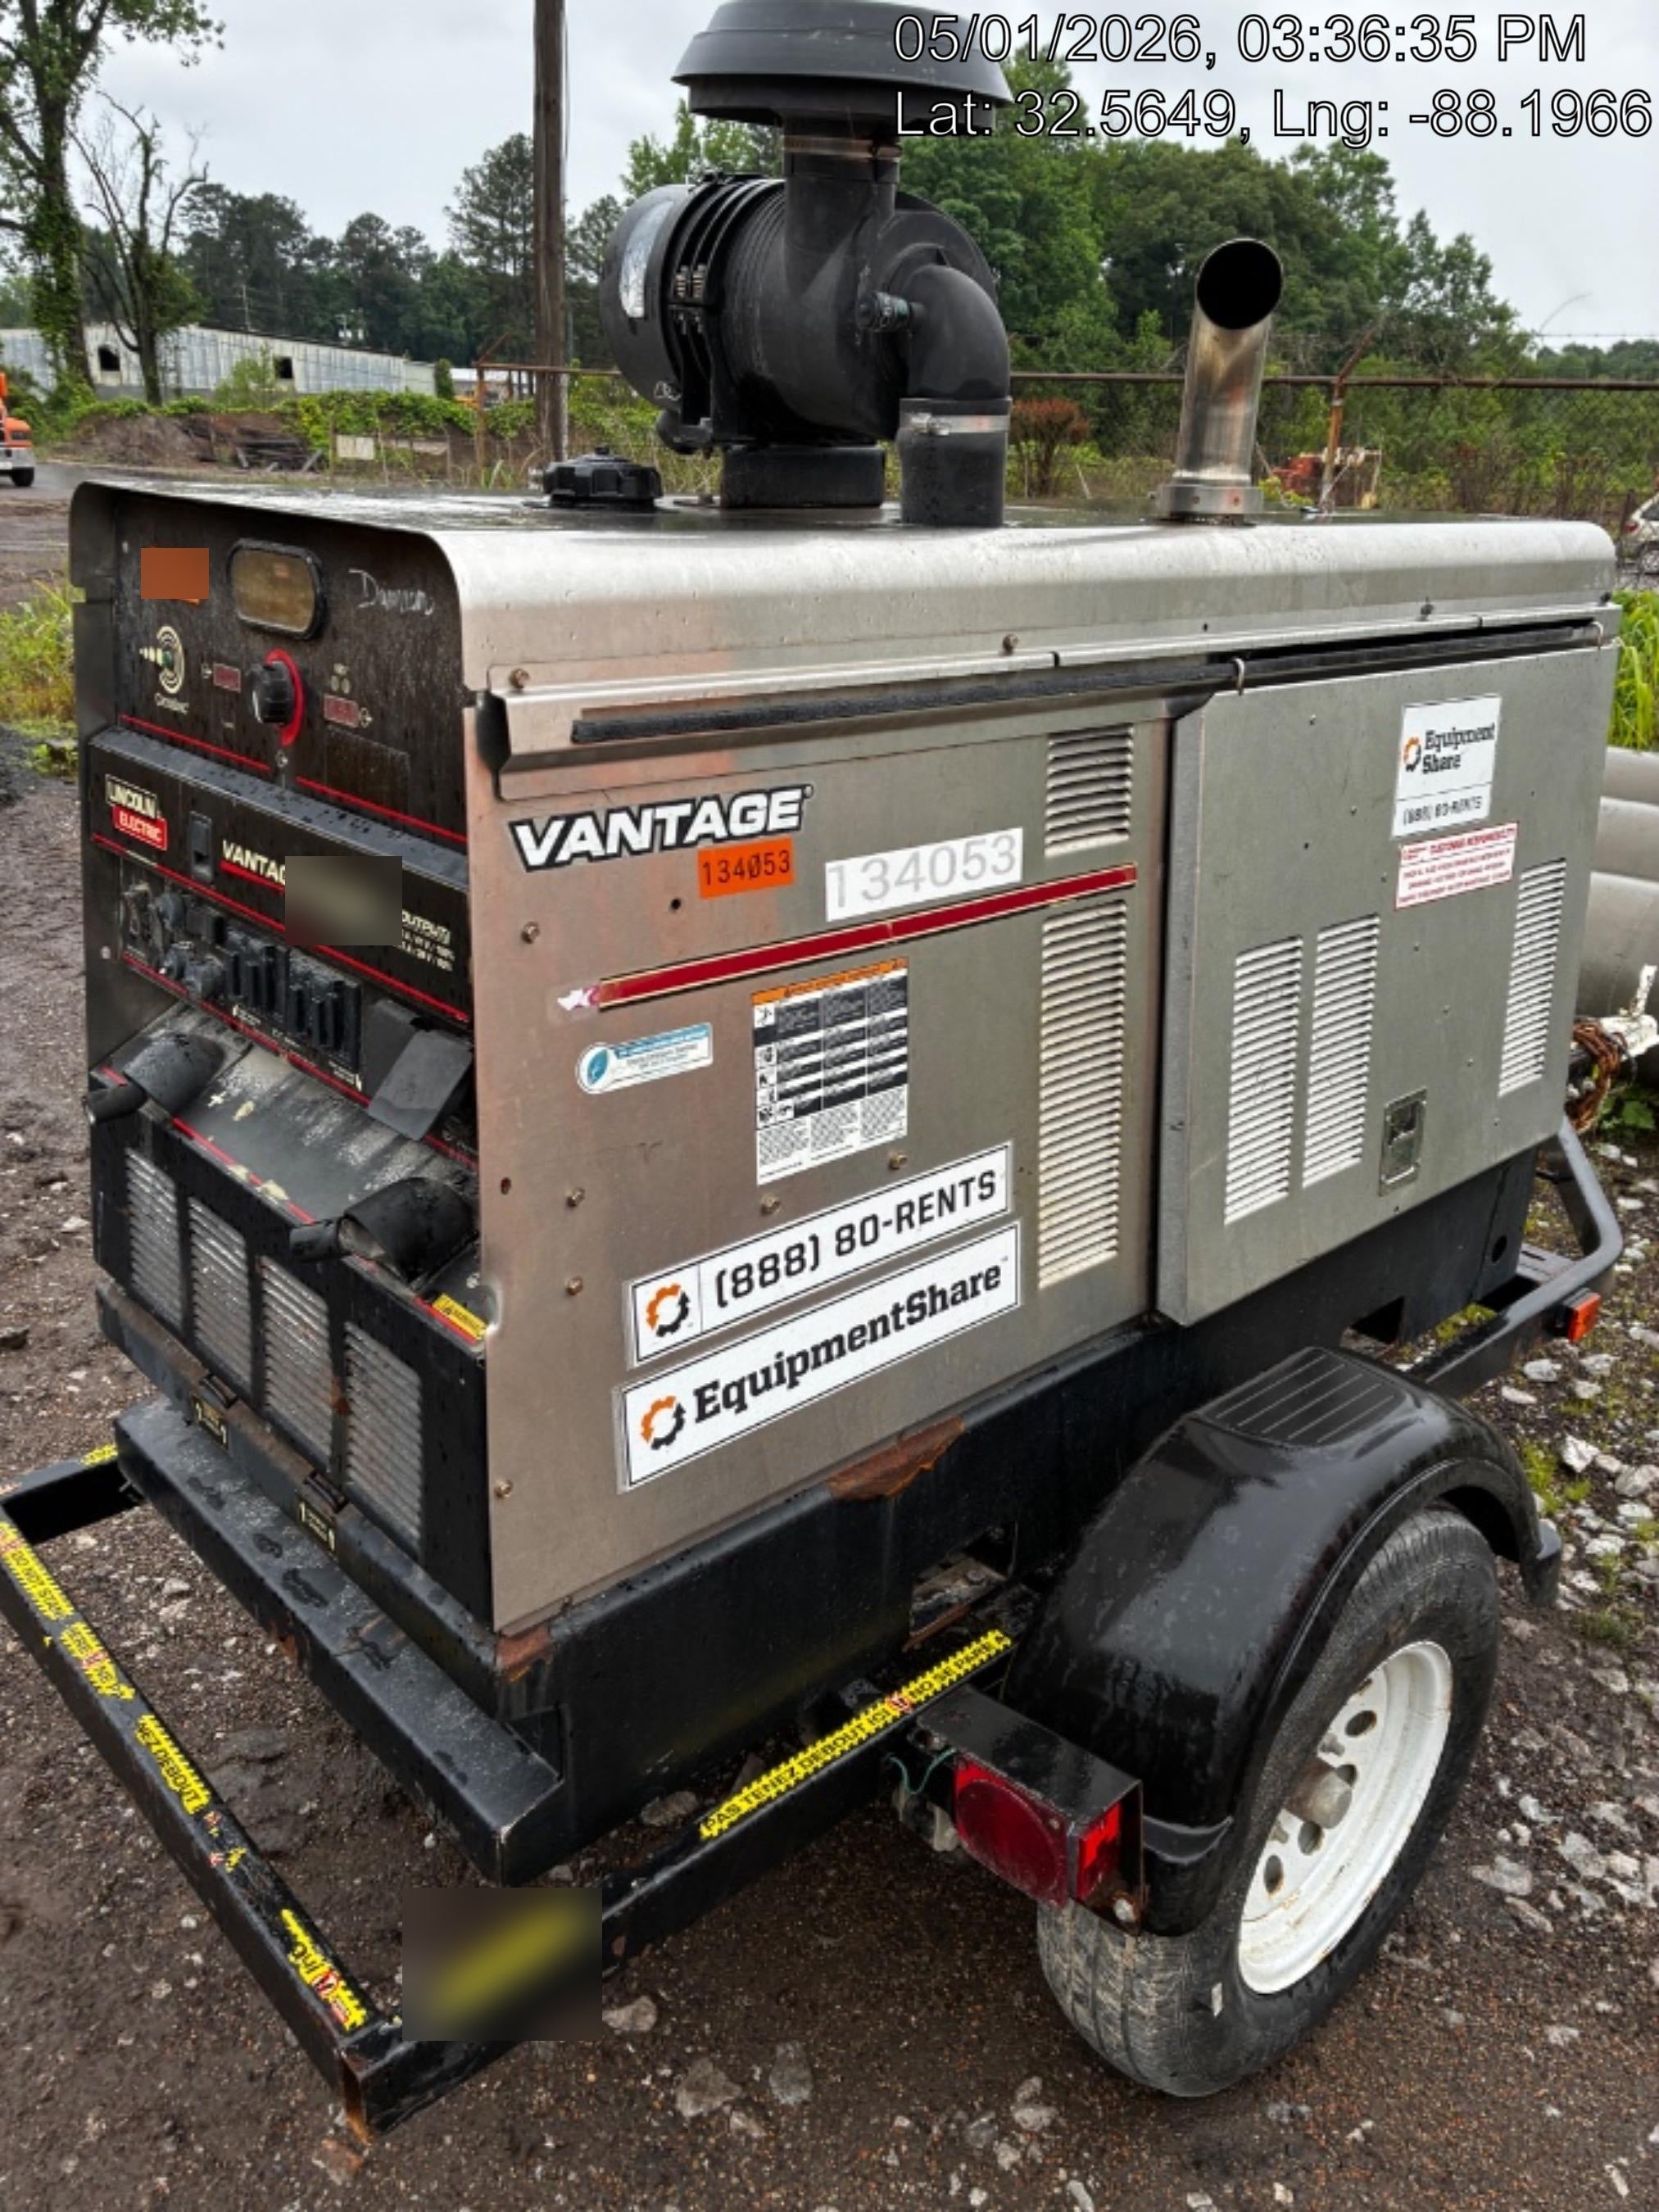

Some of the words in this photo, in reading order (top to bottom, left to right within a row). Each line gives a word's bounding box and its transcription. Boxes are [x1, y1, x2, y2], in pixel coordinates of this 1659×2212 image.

[1422, 754, 1462, 775] Share
[1424, 723, 1496, 753] Equipment
[510, 786, 806, 872] VANTAGE
[702, 851, 791, 886] 134053
[826, 832, 1018, 909] 134053
[714, 1234, 820, 1308] (888)
[835, 1169, 997, 1258] 80-RENTS
[692, 1264, 1002, 1424] EquipmentShare
